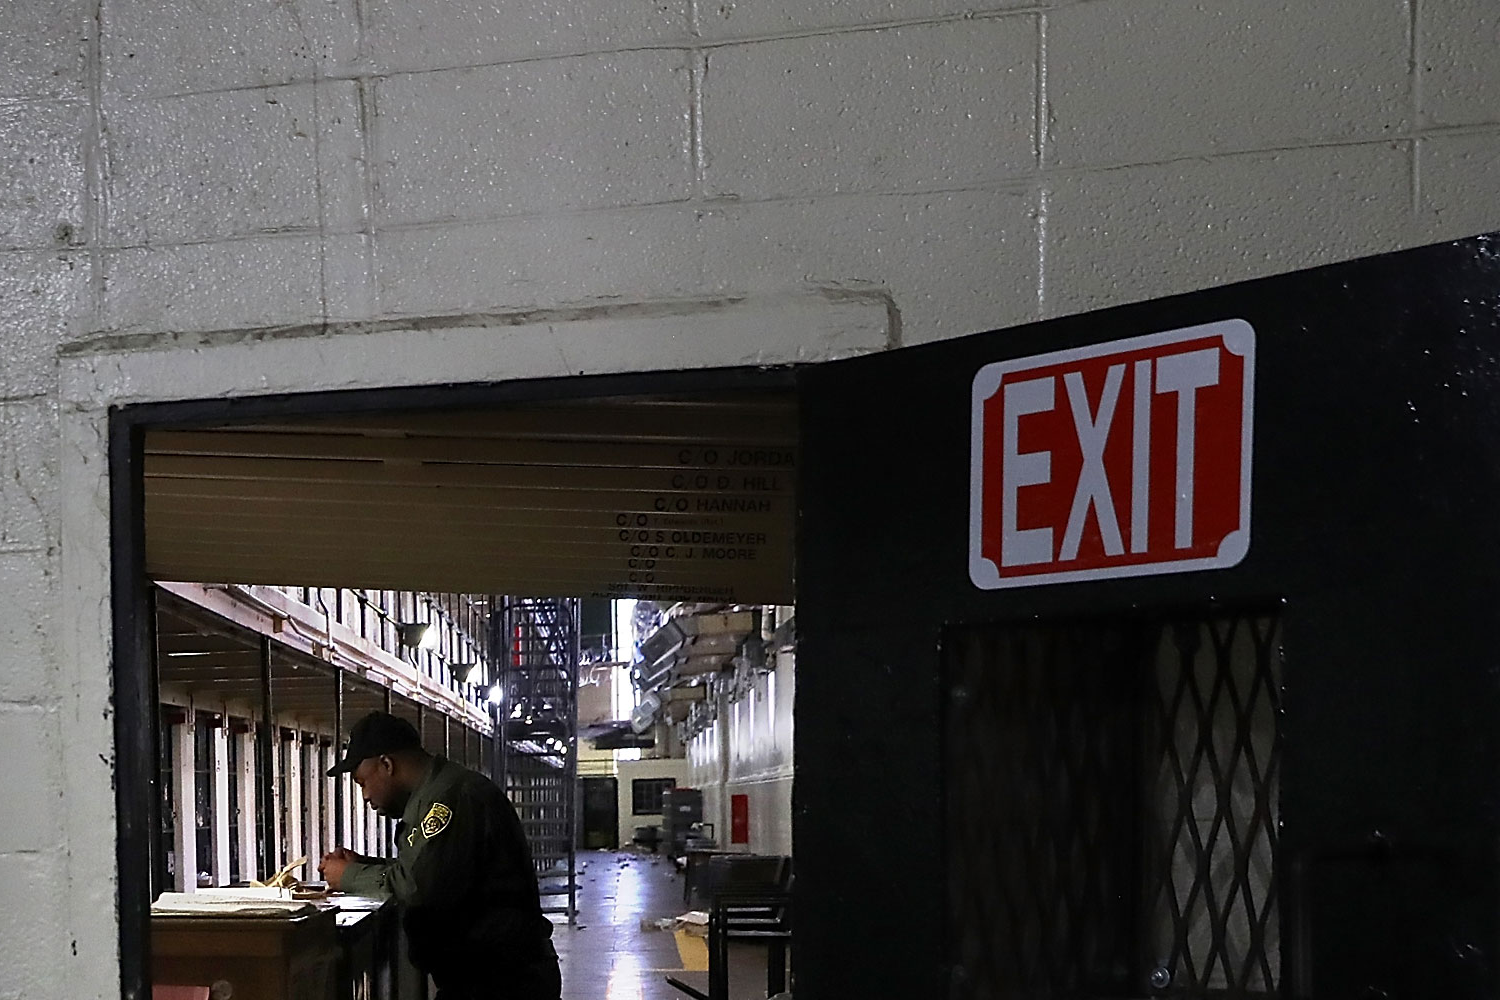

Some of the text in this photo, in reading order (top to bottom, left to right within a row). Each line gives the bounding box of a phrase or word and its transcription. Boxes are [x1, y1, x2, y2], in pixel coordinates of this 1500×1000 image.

[1001, 347, 1220, 567] EXIT
[743, 476, 782, 490] HILL
[654, 497, 771, 512] C/O HANNAH
[616, 513, 648, 527] C/O
[619, 529, 649, 543] C/O
[671, 531, 766, 544] OLDEMEYER
[702, 548, 757, 560] MOORE
